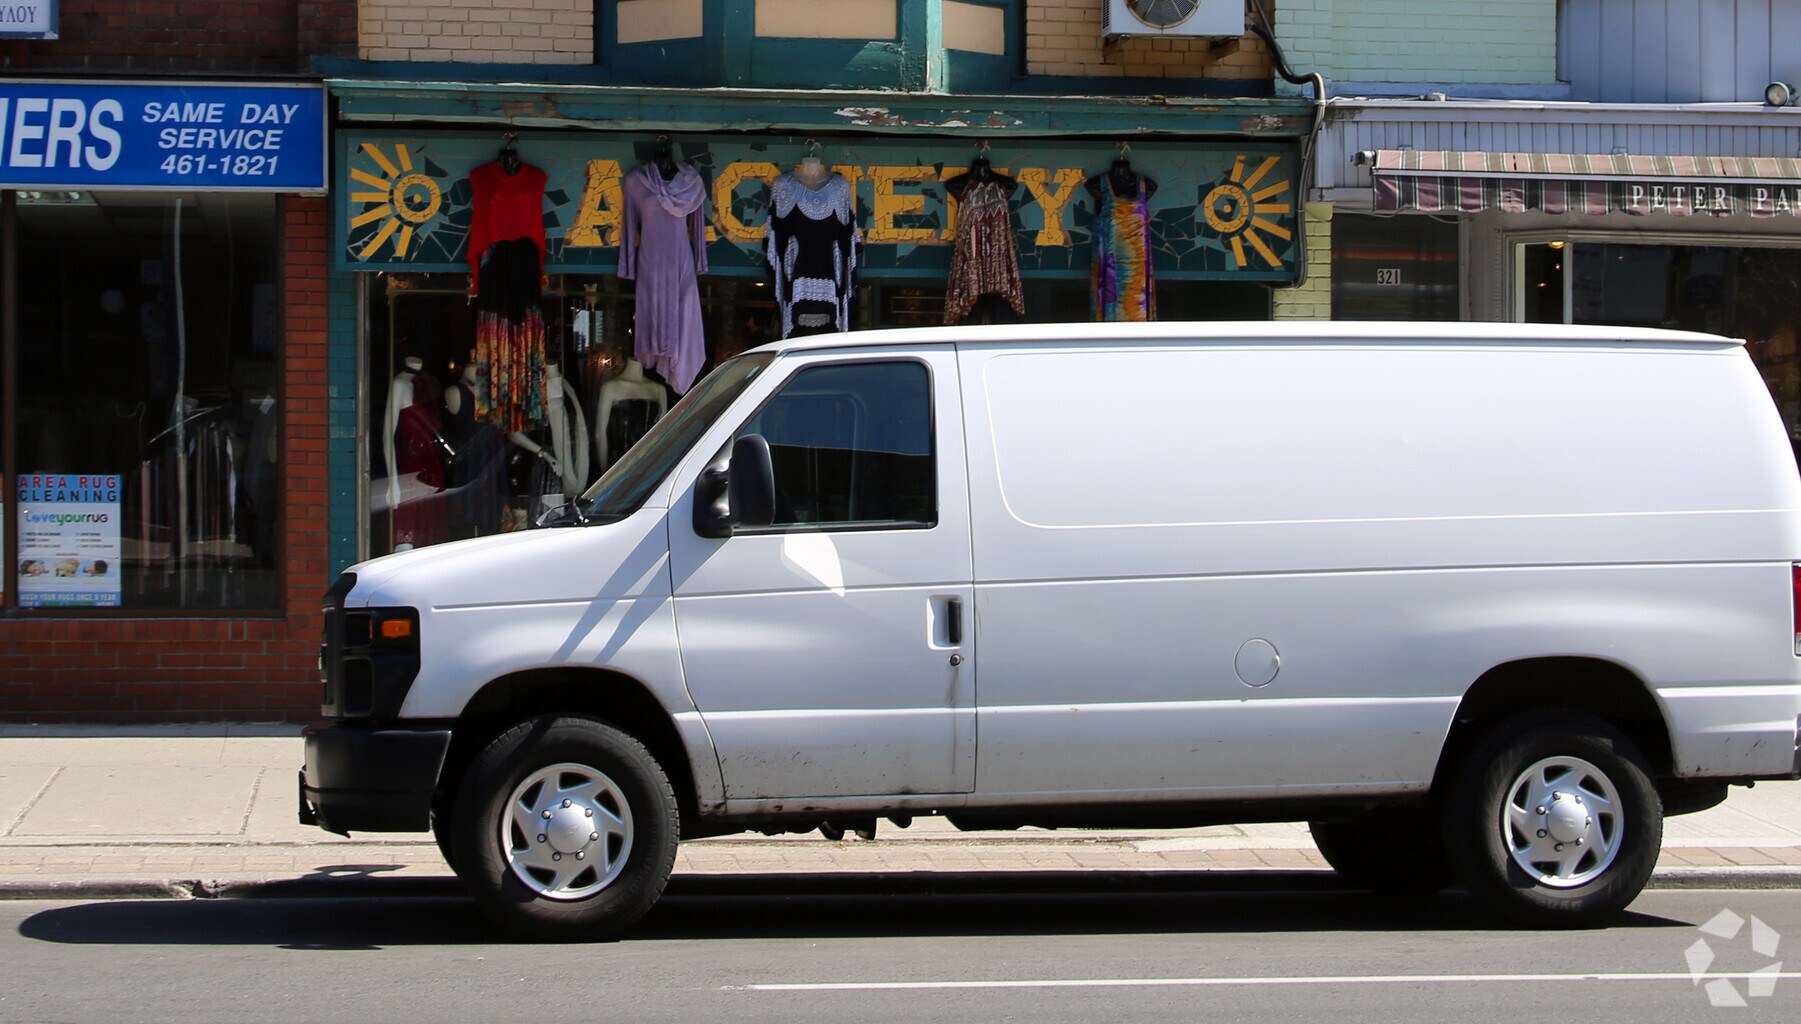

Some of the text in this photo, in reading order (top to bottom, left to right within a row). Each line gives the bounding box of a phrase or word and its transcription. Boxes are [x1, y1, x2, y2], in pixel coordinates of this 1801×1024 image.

[142, 102, 300, 124] SAME DAY
[0, 97, 124, 171] ERS
[158, 128, 283, 150] SERVICE
[160, 154, 278, 176] 461-1821
[1632, 185, 1728, 210] PETER
[1378, 269, 1399, 285] 321
[20, 476, 116, 488] AREA RUG
[19, 490, 117, 502] CLEANING
